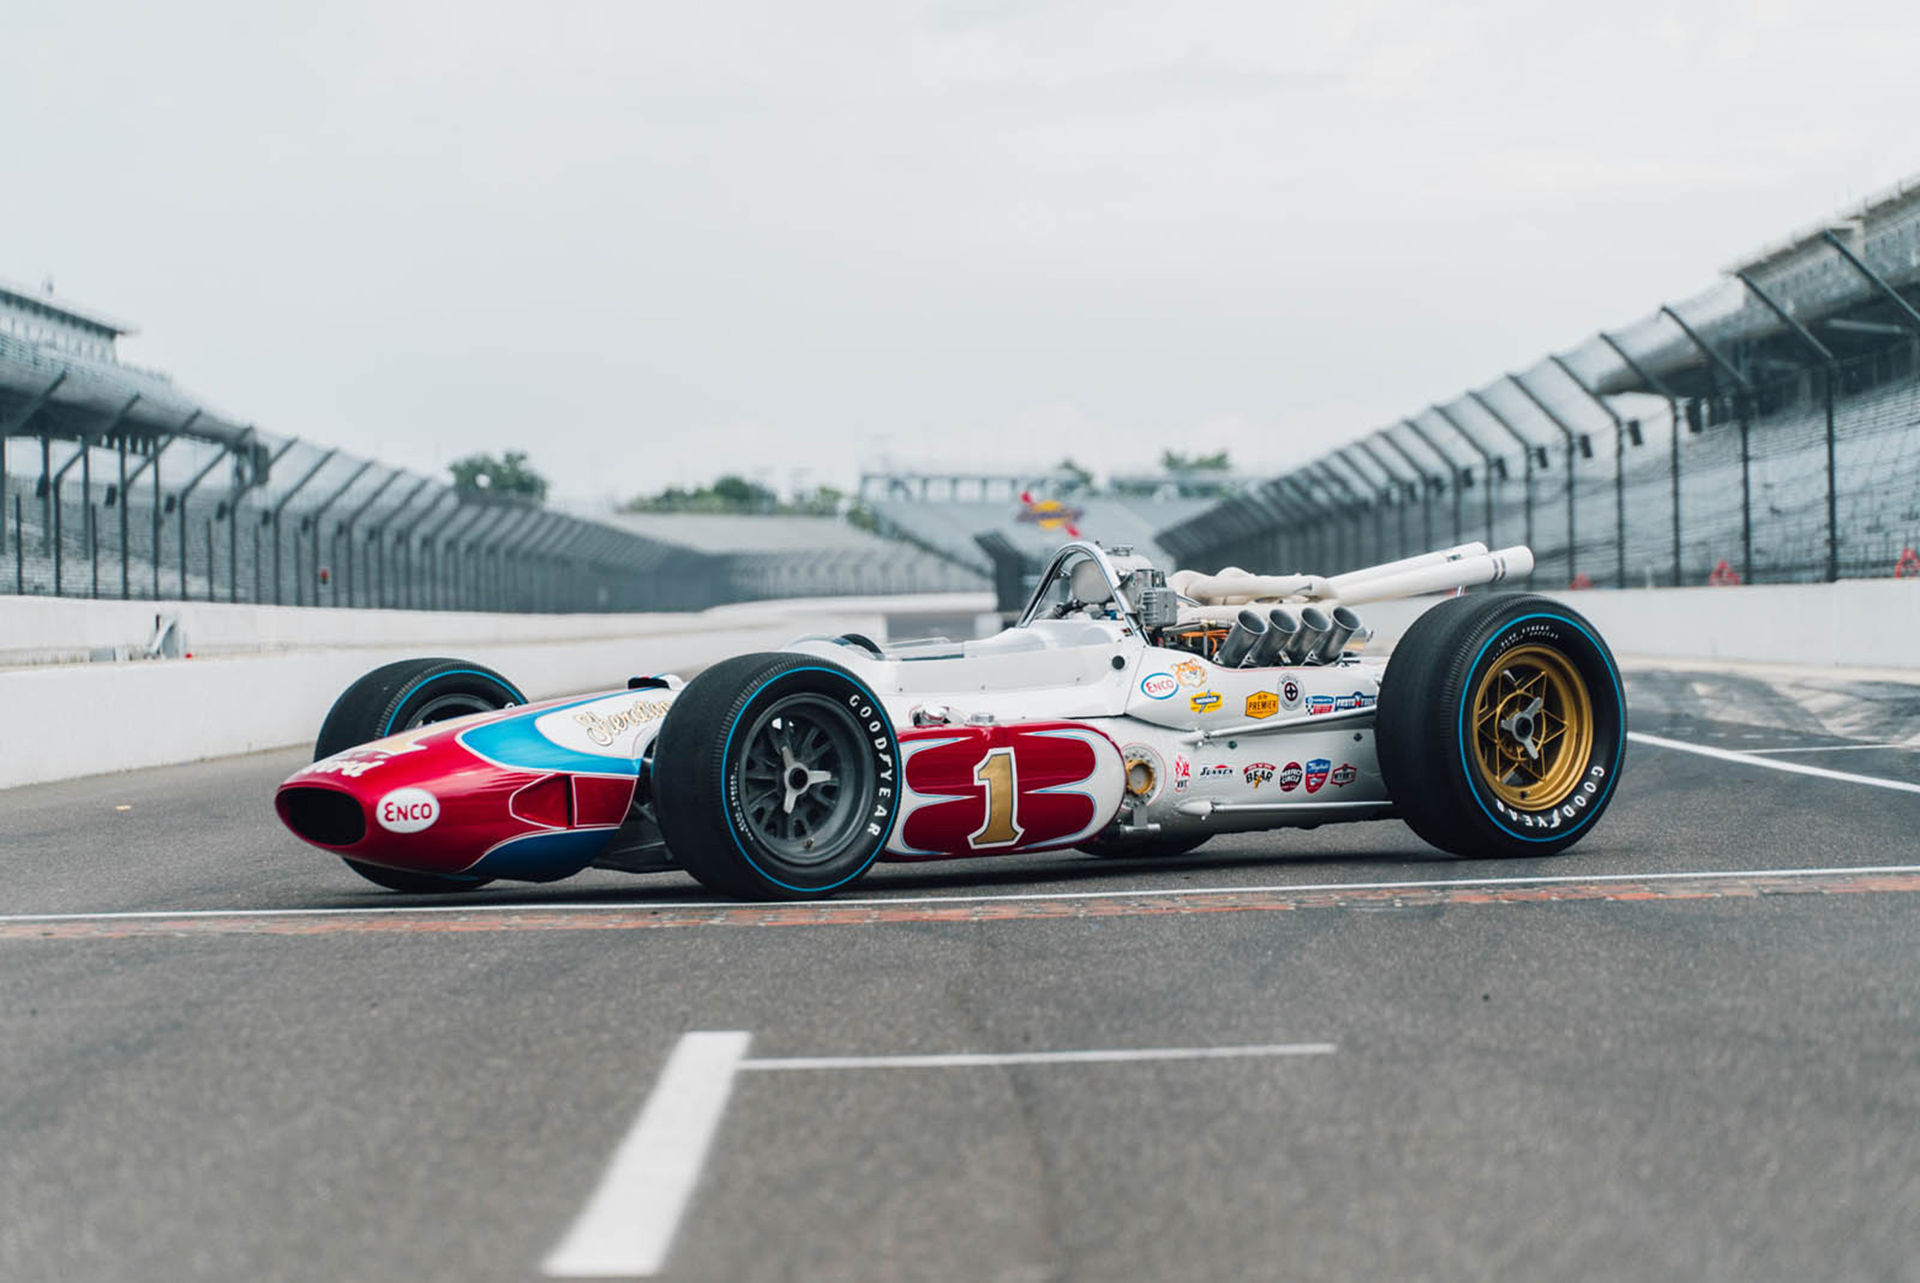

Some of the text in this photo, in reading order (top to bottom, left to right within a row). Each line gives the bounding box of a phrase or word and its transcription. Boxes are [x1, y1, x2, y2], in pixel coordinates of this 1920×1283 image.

[1145, 679, 1174, 694] ENCO
[1248, 700, 1277, 711] PREMIER
[849, 694, 893, 837] GOODYEAR
[1245, 770, 1273, 785] BEAR
[967, 746, 1025, 850] 1
[1496, 765, 1605, 828] GOODYEAR
[384, 801, 433, 823] ENCO
